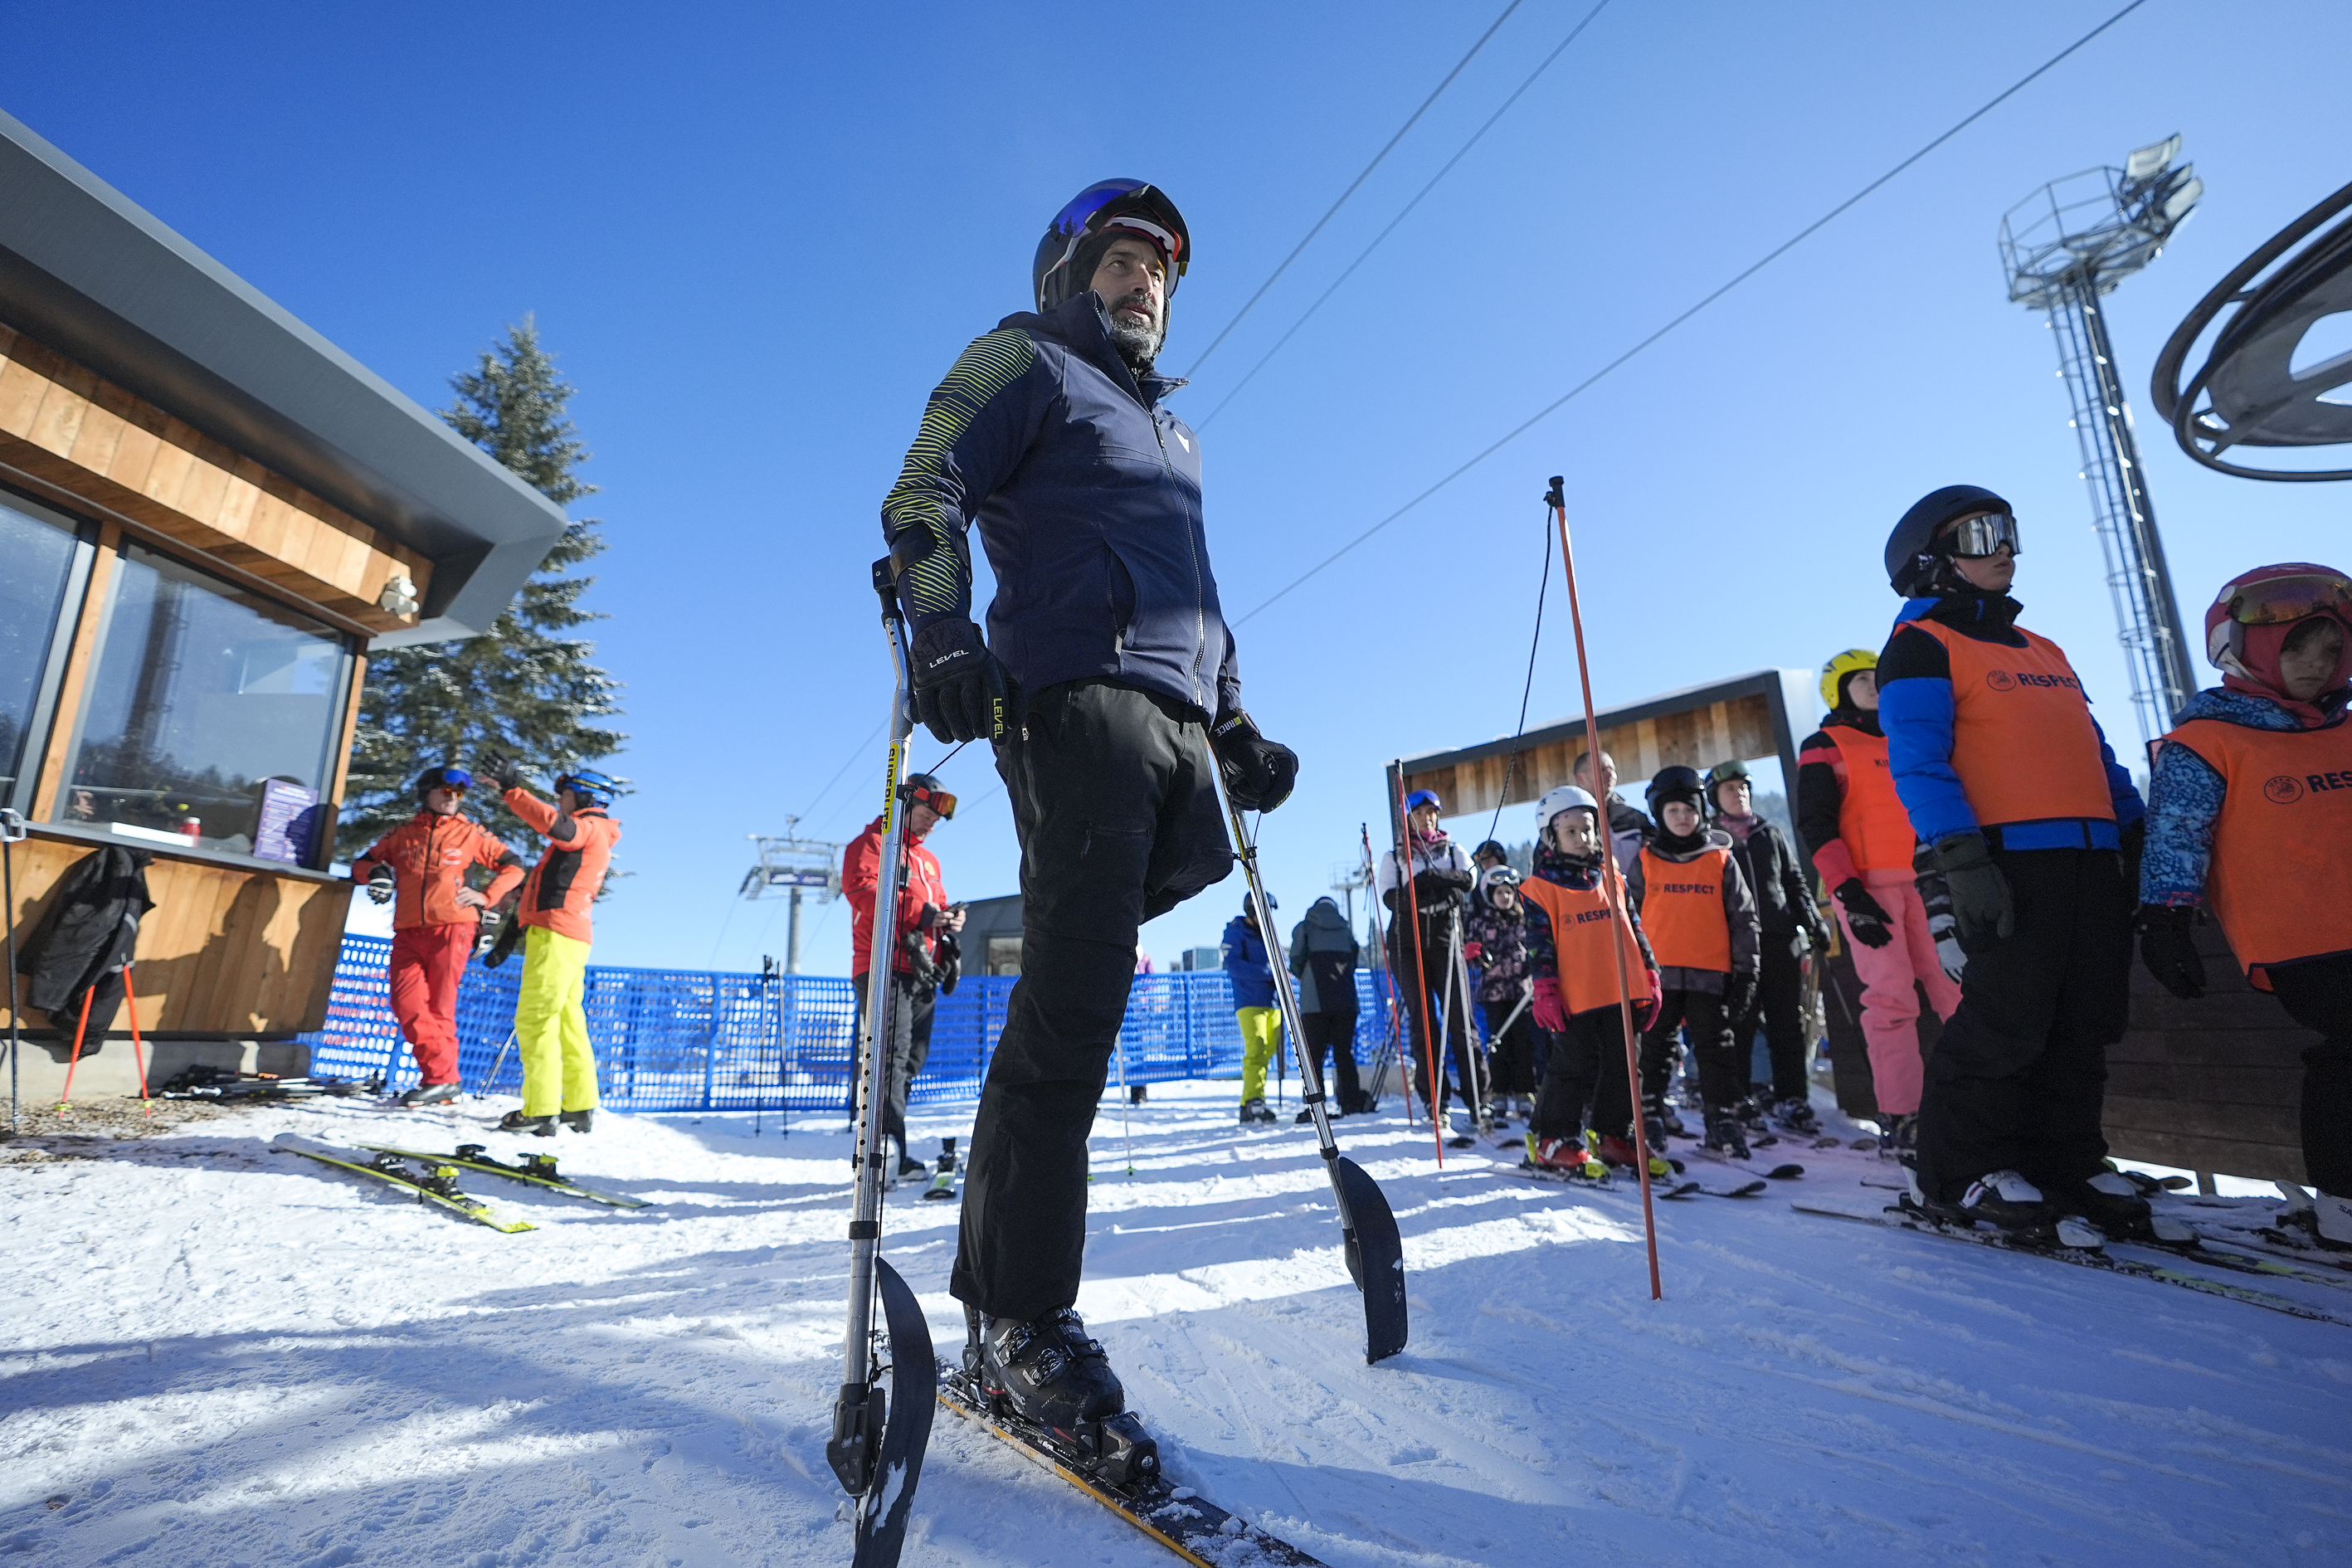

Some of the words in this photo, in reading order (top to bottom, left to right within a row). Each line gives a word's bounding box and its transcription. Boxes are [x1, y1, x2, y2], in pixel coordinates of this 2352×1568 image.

[929, 650, 969, 669] LEVEL
[993, 698, 1004, 739] LEVEL
[1215, 719, 1236, 738] RACE
[1663, 883, 1715, 895] RESPECT
